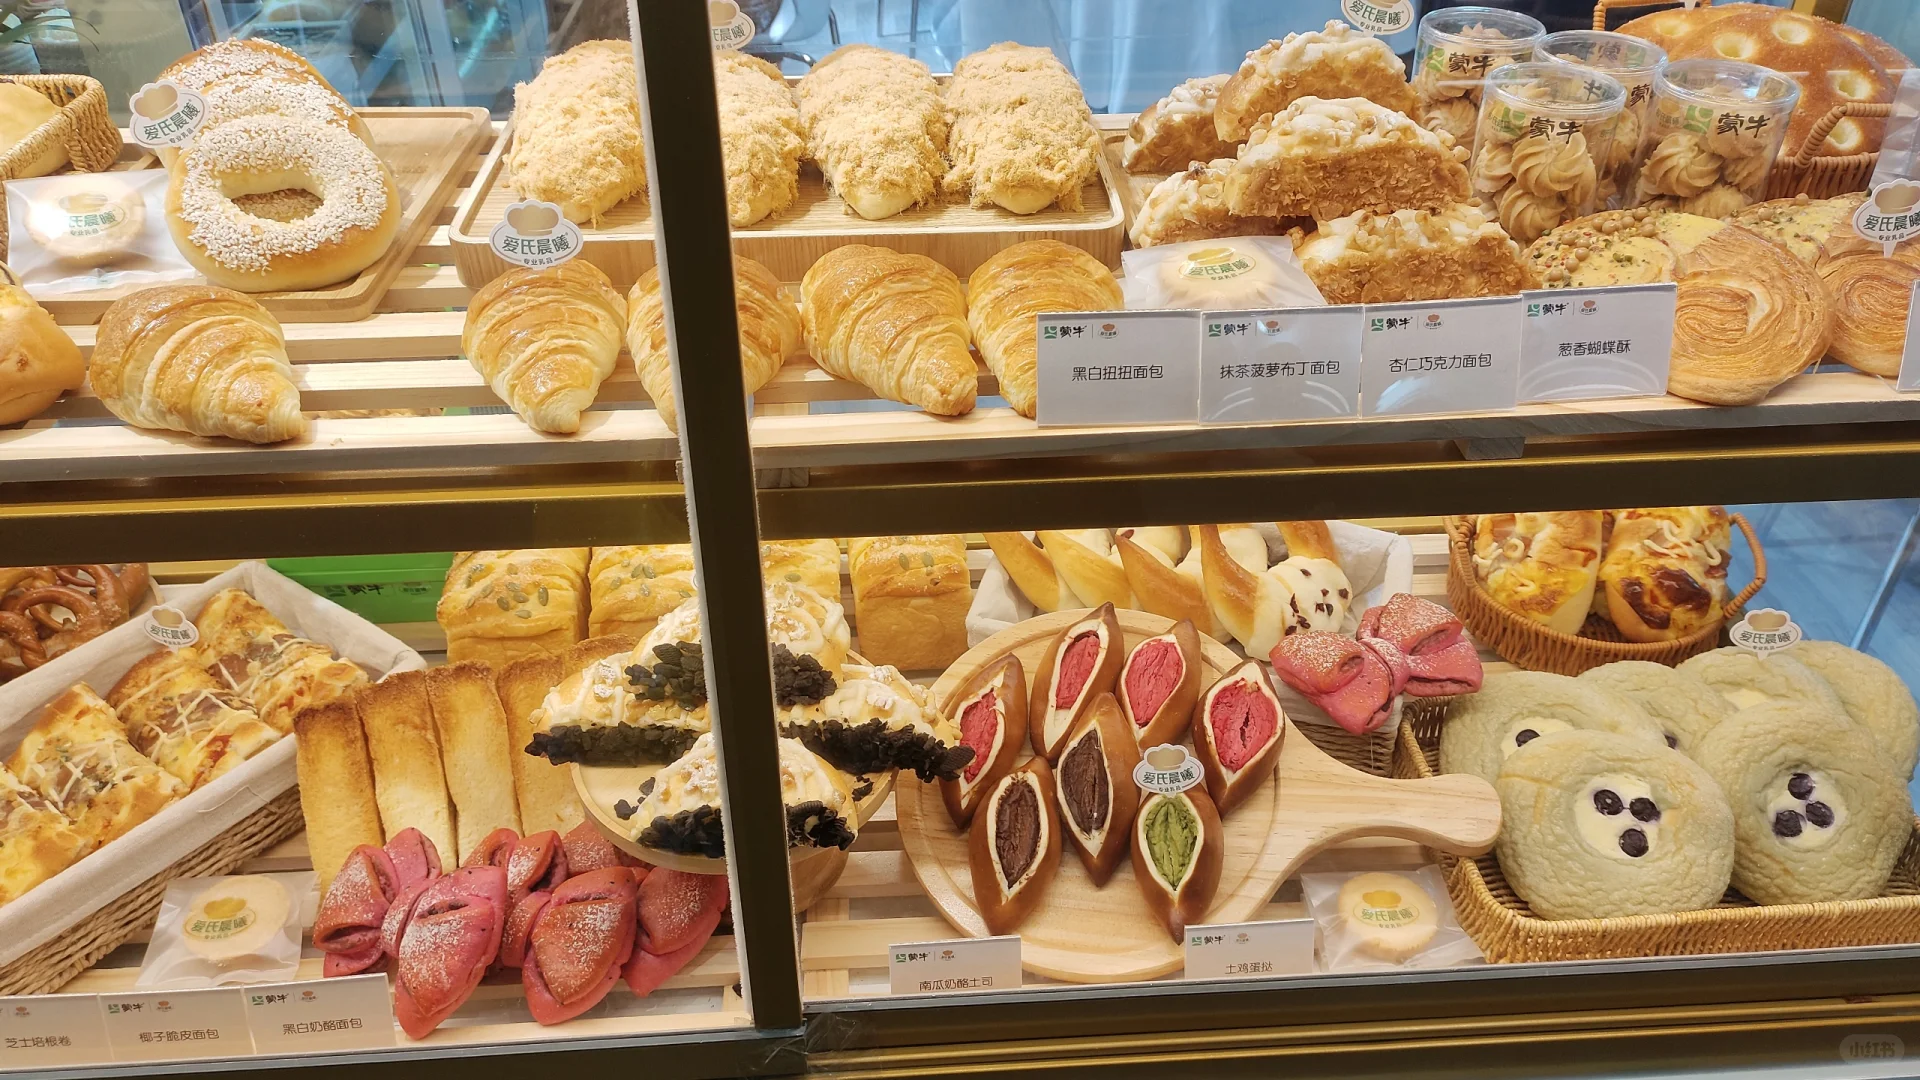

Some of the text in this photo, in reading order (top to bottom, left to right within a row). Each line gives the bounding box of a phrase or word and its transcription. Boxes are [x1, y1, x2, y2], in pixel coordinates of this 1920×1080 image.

[1349, 0, 1401, 26] 爱氏晨曦
[711, 24, 745, 41] 氏晨曦
[1448, 51, 1496, 77] 蒙牛
[1630, 84, 1651, 106] 蒙
[143, 102, 200, 140] 爱氏晨曦
[1717, 112, 1770, 138] 蒙牛
[1529, 116, 1583, 144] 蒙牛
[67, 210, 118, 228] 氏晨曦
[502, 234, 571, 255] 爱氏晨曦
[523, 257, 553, 266] 专业乳品
[1189, 258, 1250, 276] 爱氏晨曦
[1542, 303, 1567, 316] 蒙牛
[1059, 325, 1086, 339] 蒙牛
[1223, 323, 1249, 336] 蒙牛
[1386, 317, 1411, 330] 蒙牛
[1558, 338, 1632, 357] 葱香蝴蝶酥
[1220, 360, 1340, 379] 抹茶菠萝布丁面包
[1388, 352, 1492, 373] 杏仁巧克力面包
[1071, 364, 1164, 382] 黑白扭扭面包
[150, 624, 192, 640] 爱氏晨曦
[1739, 630, 1791, 644] 爱氏晨曦
[1142, 768, 1195, 785] 爱氏晨曦
[1360, 908, 1414, 922] 爱氏晨曦
[191, 916, 248, 933] 爱氏晨曦
[1204, 935, 1225, 945] 蒙牛
[908, 952, 928, 962] 蒙牛
[1225, 960, 1273, 975] 土鸡蛋挞
[919, 976, 993, 992] 南瓜奶酪土司
[265, 993, 289, 1004] 蒙牛
[121, 1003, 144, 1013] 蒙牛
[282, 1017, 363, 1036] 黑白奶酪面包
[4, 1035, 72, 1049] 芝士培根卷
[138, 1028, 220, 1043] 椰子脆皮面包
